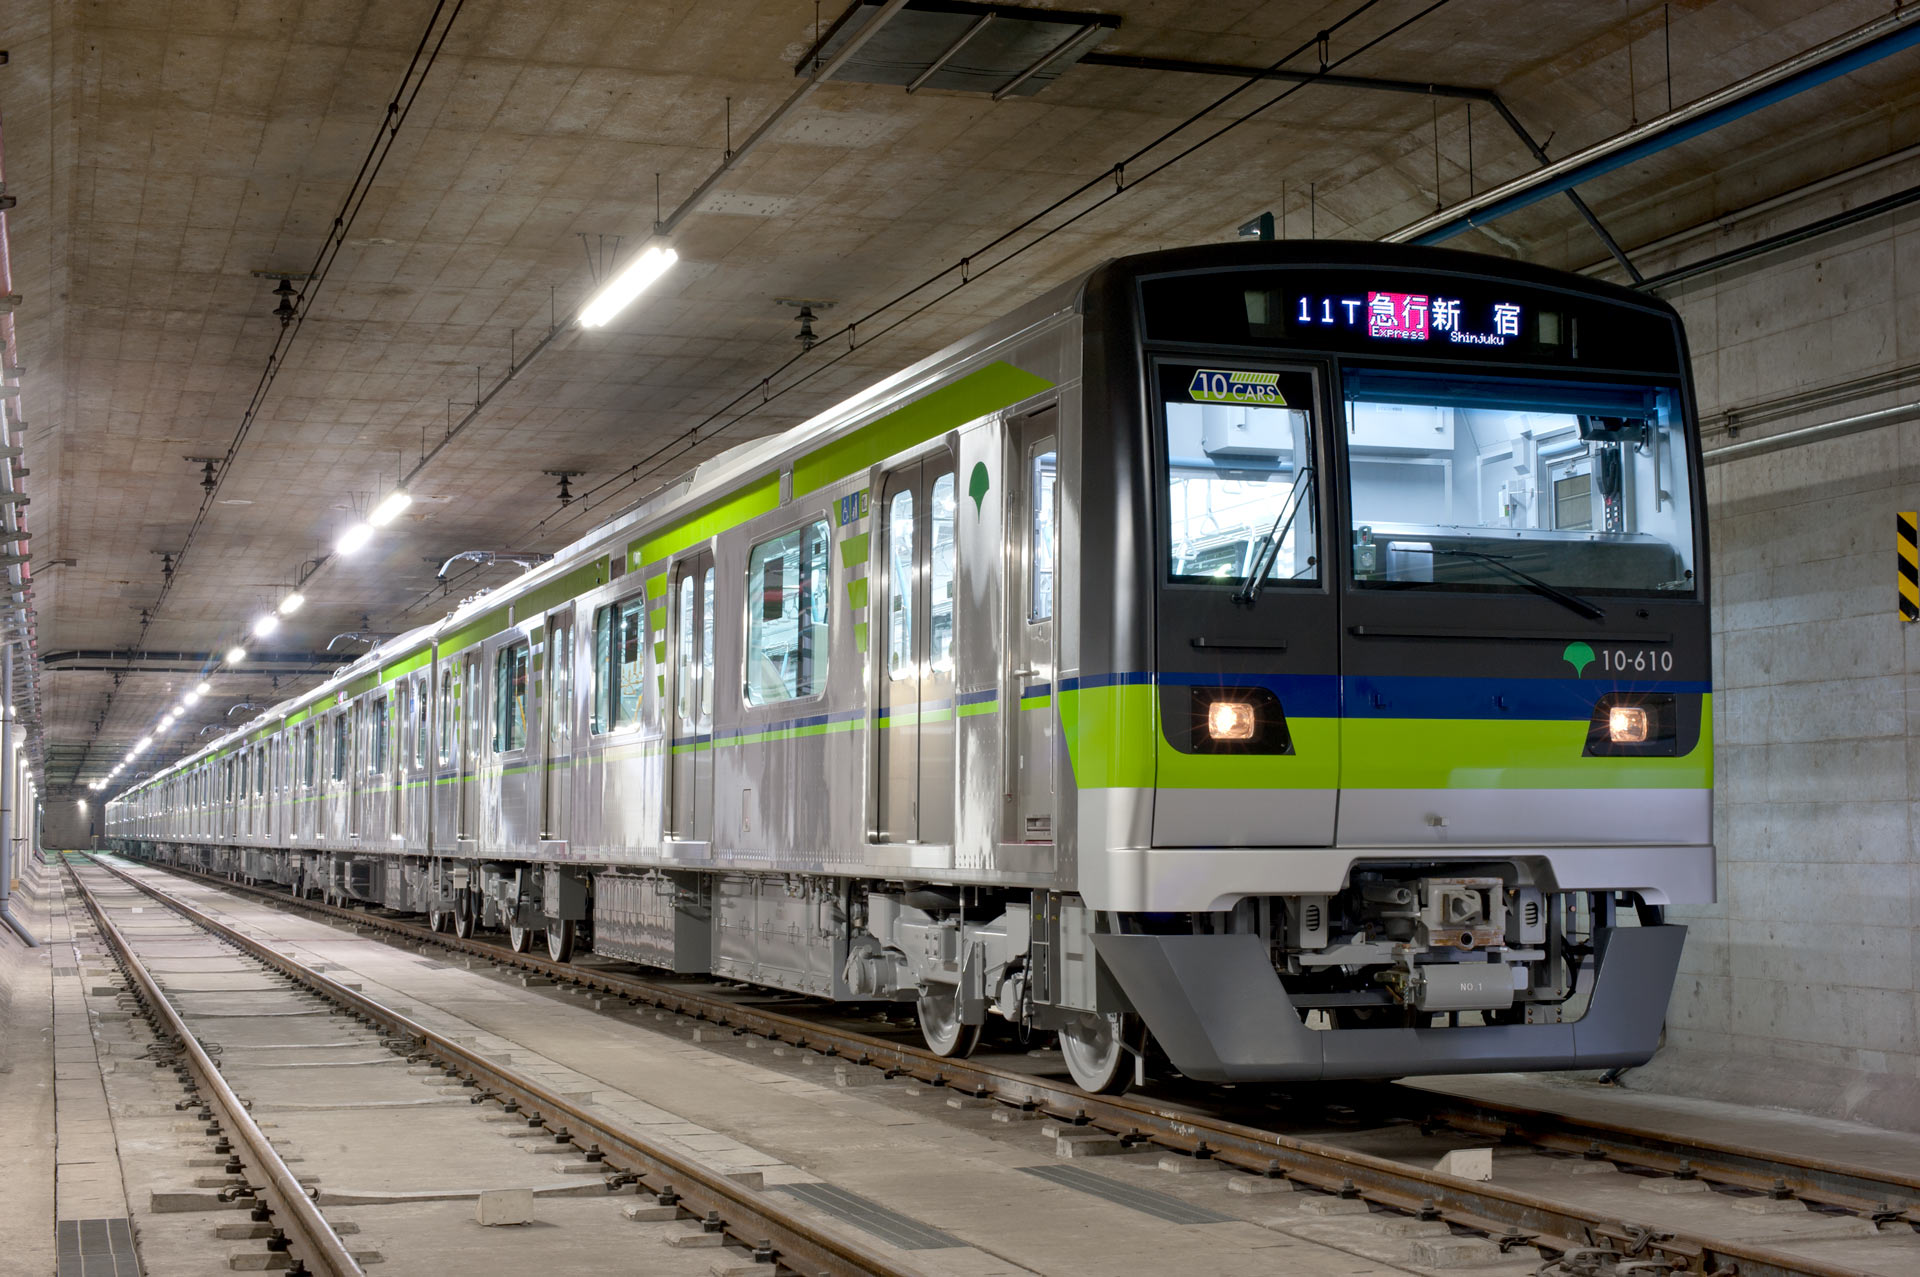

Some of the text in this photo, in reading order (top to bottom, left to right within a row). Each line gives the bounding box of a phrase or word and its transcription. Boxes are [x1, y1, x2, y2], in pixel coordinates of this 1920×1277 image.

[1298, 297, 1361, 325] 11T
[1368, 293, 1521, 336] 急行 新宿
[1371, 325, 1426, 340] Express
[1449, 331, 1505, 345] Shinjuku
[1199, 373, 1276, 402] 10 CARS
[1602, 650, 1673, 672] 10-610
